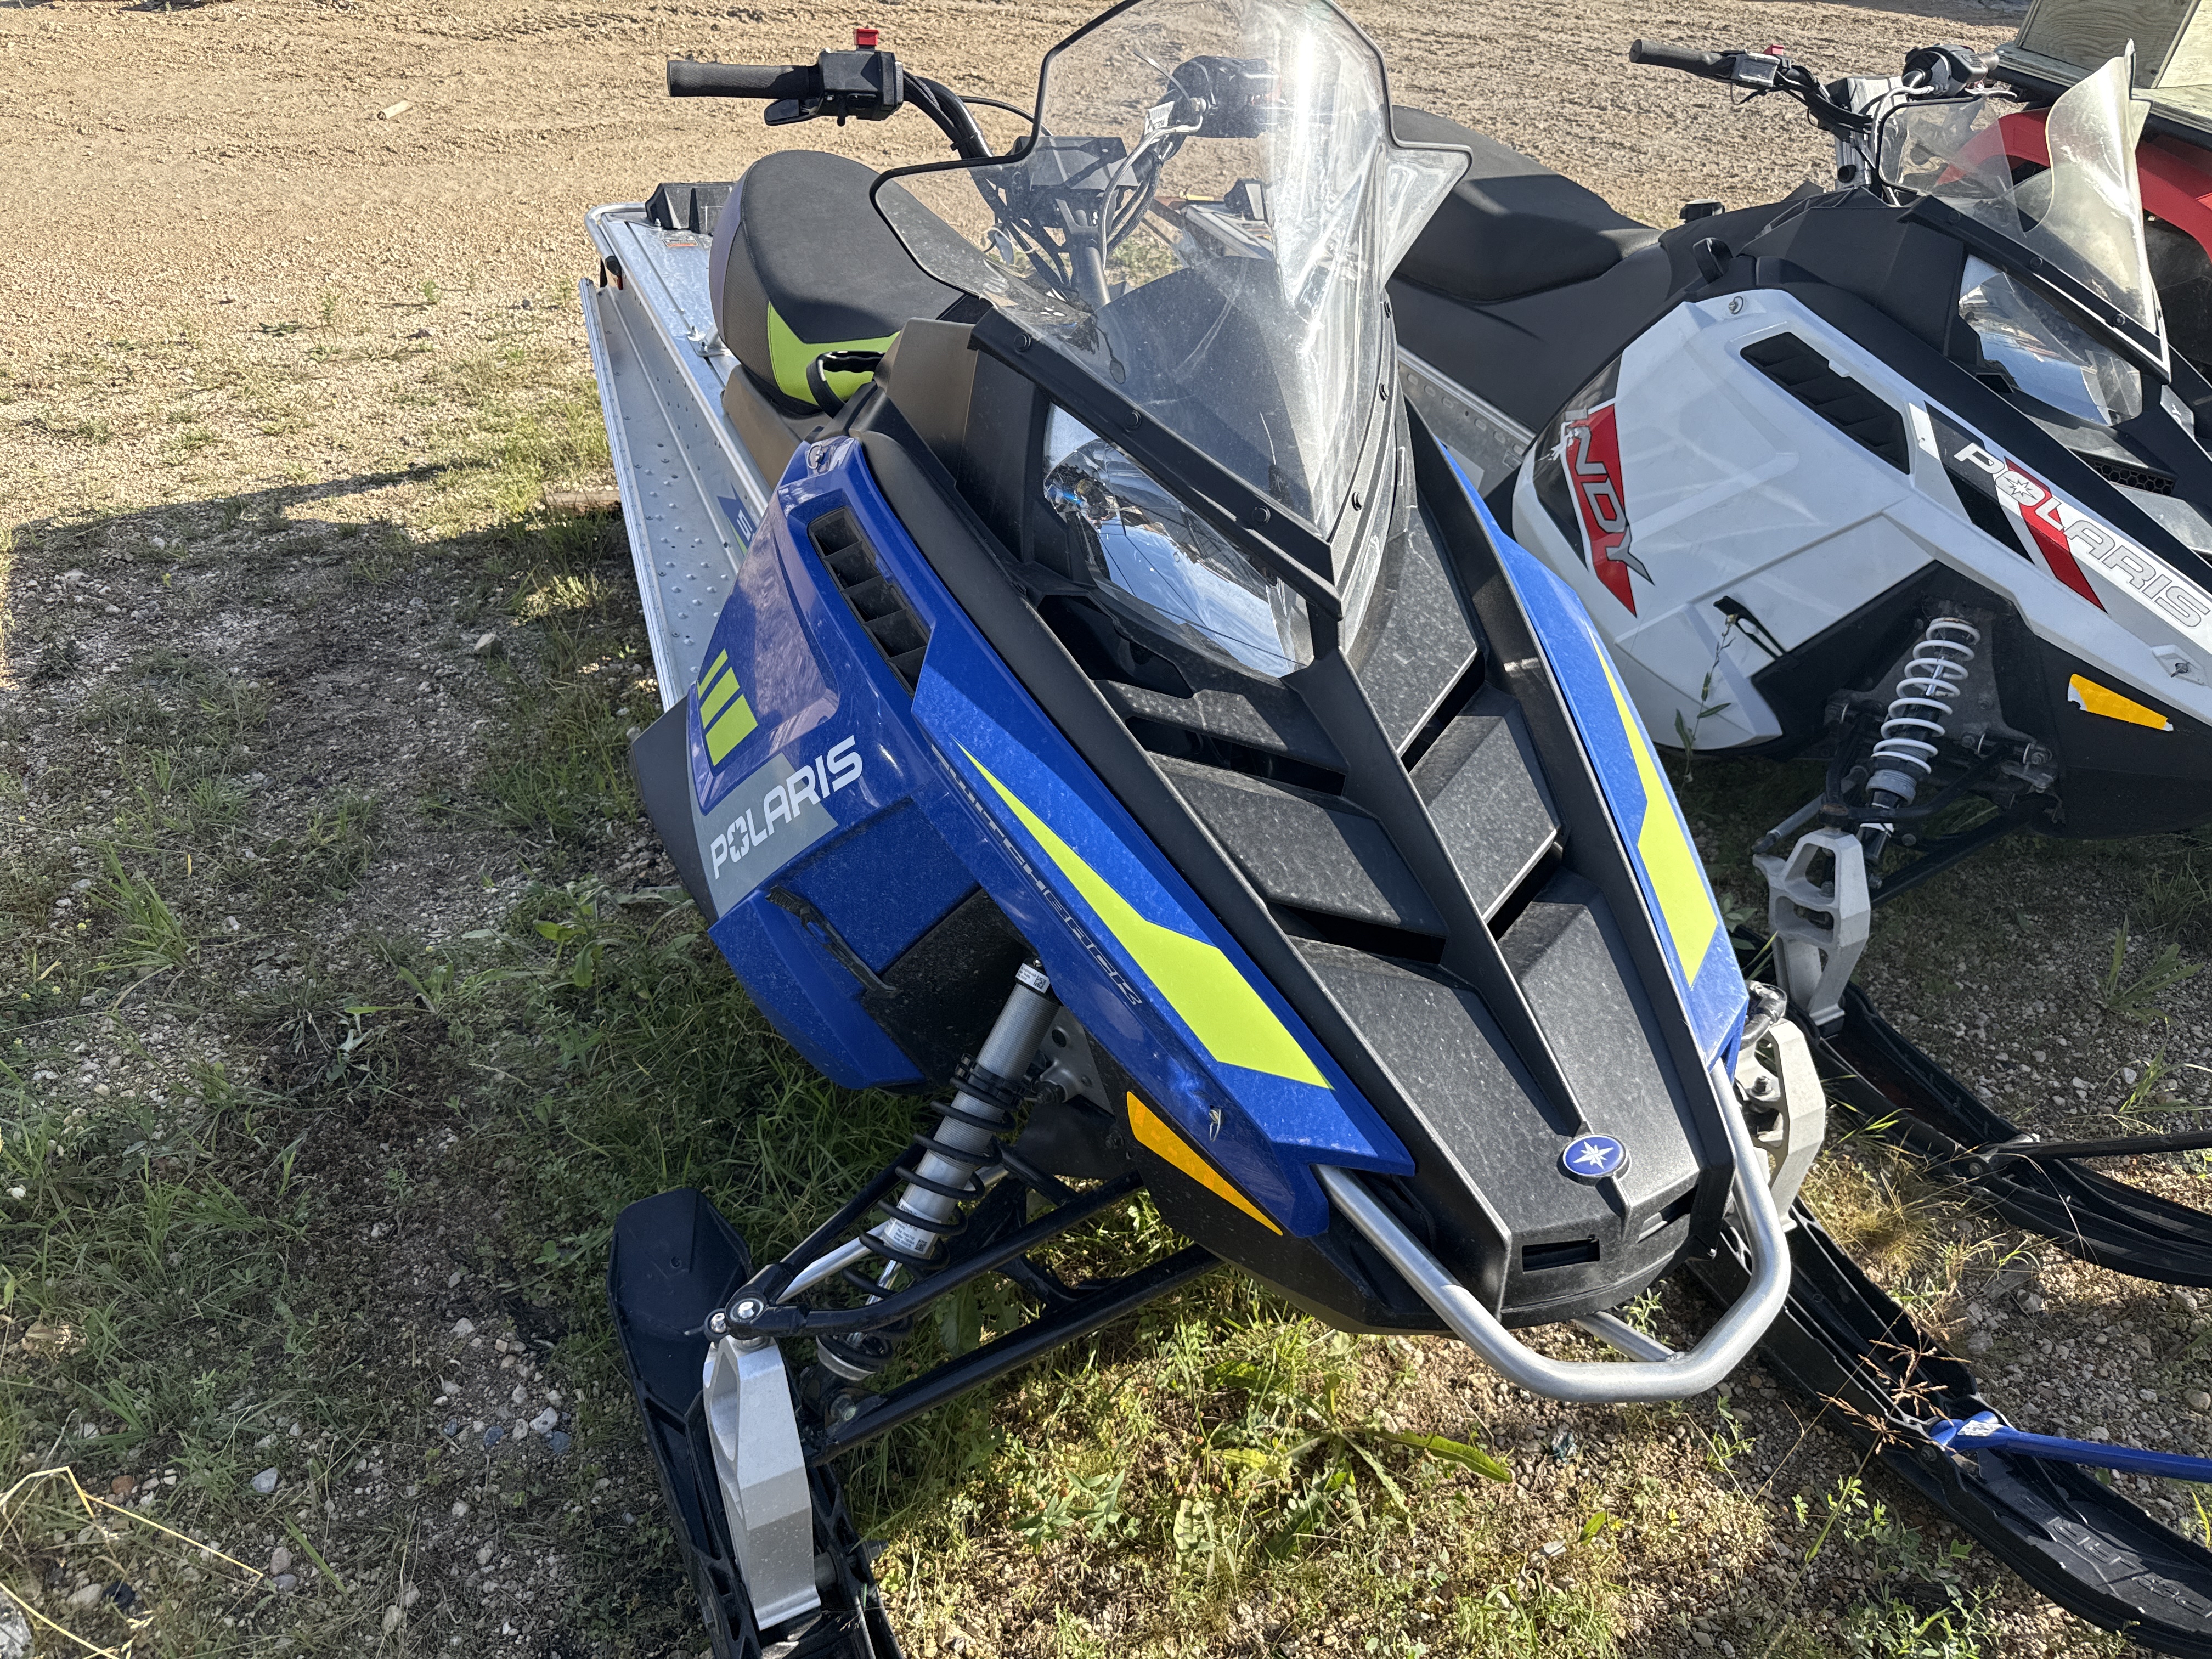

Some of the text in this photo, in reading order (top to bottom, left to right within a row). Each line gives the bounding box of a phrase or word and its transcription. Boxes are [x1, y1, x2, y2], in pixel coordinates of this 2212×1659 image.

[1953, 442, 2211, 628] POLARIS
[710, 735, 863, 880] POLARIS
[931, 743, 1143, 1006] SWITCHBACK
